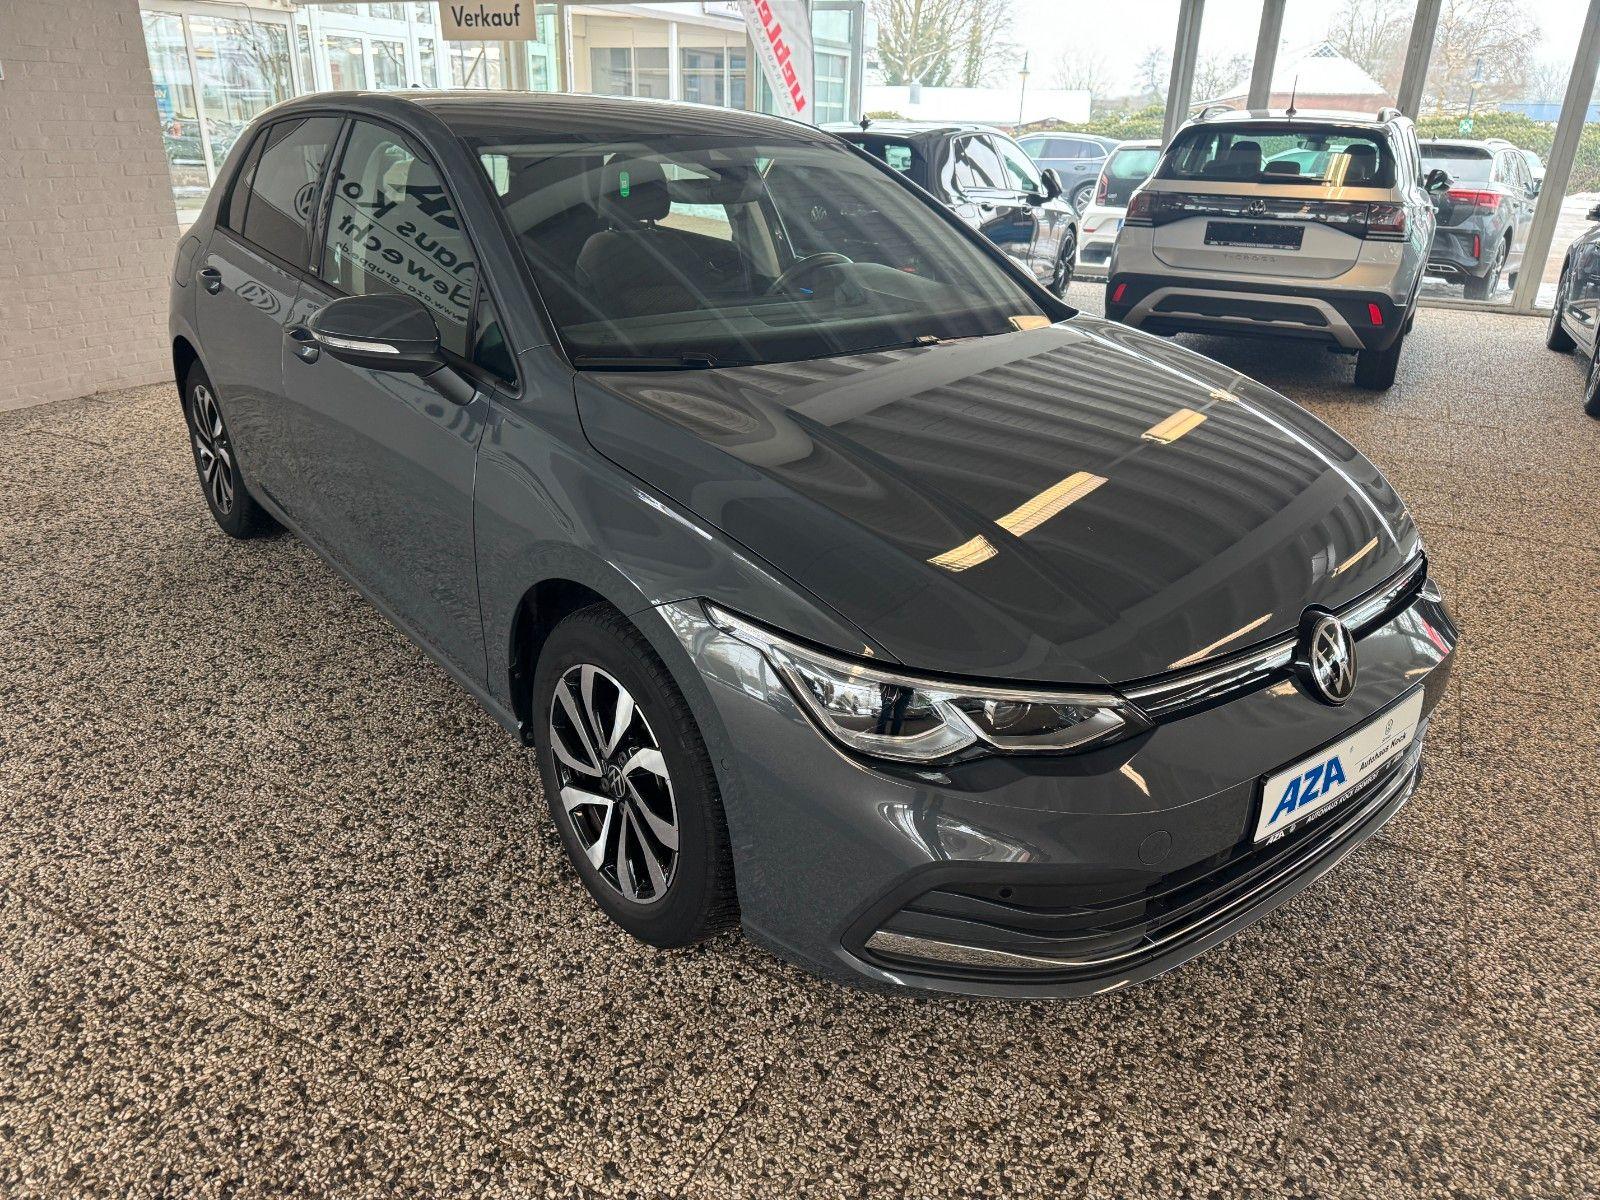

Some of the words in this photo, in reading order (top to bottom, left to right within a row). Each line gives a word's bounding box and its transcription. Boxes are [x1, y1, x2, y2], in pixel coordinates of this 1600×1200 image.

[451, 4, 520, 27] Verkauf
[1359, 745, 1389, 772] Autohaus
[1265, 756, 1347, 828] AZA
